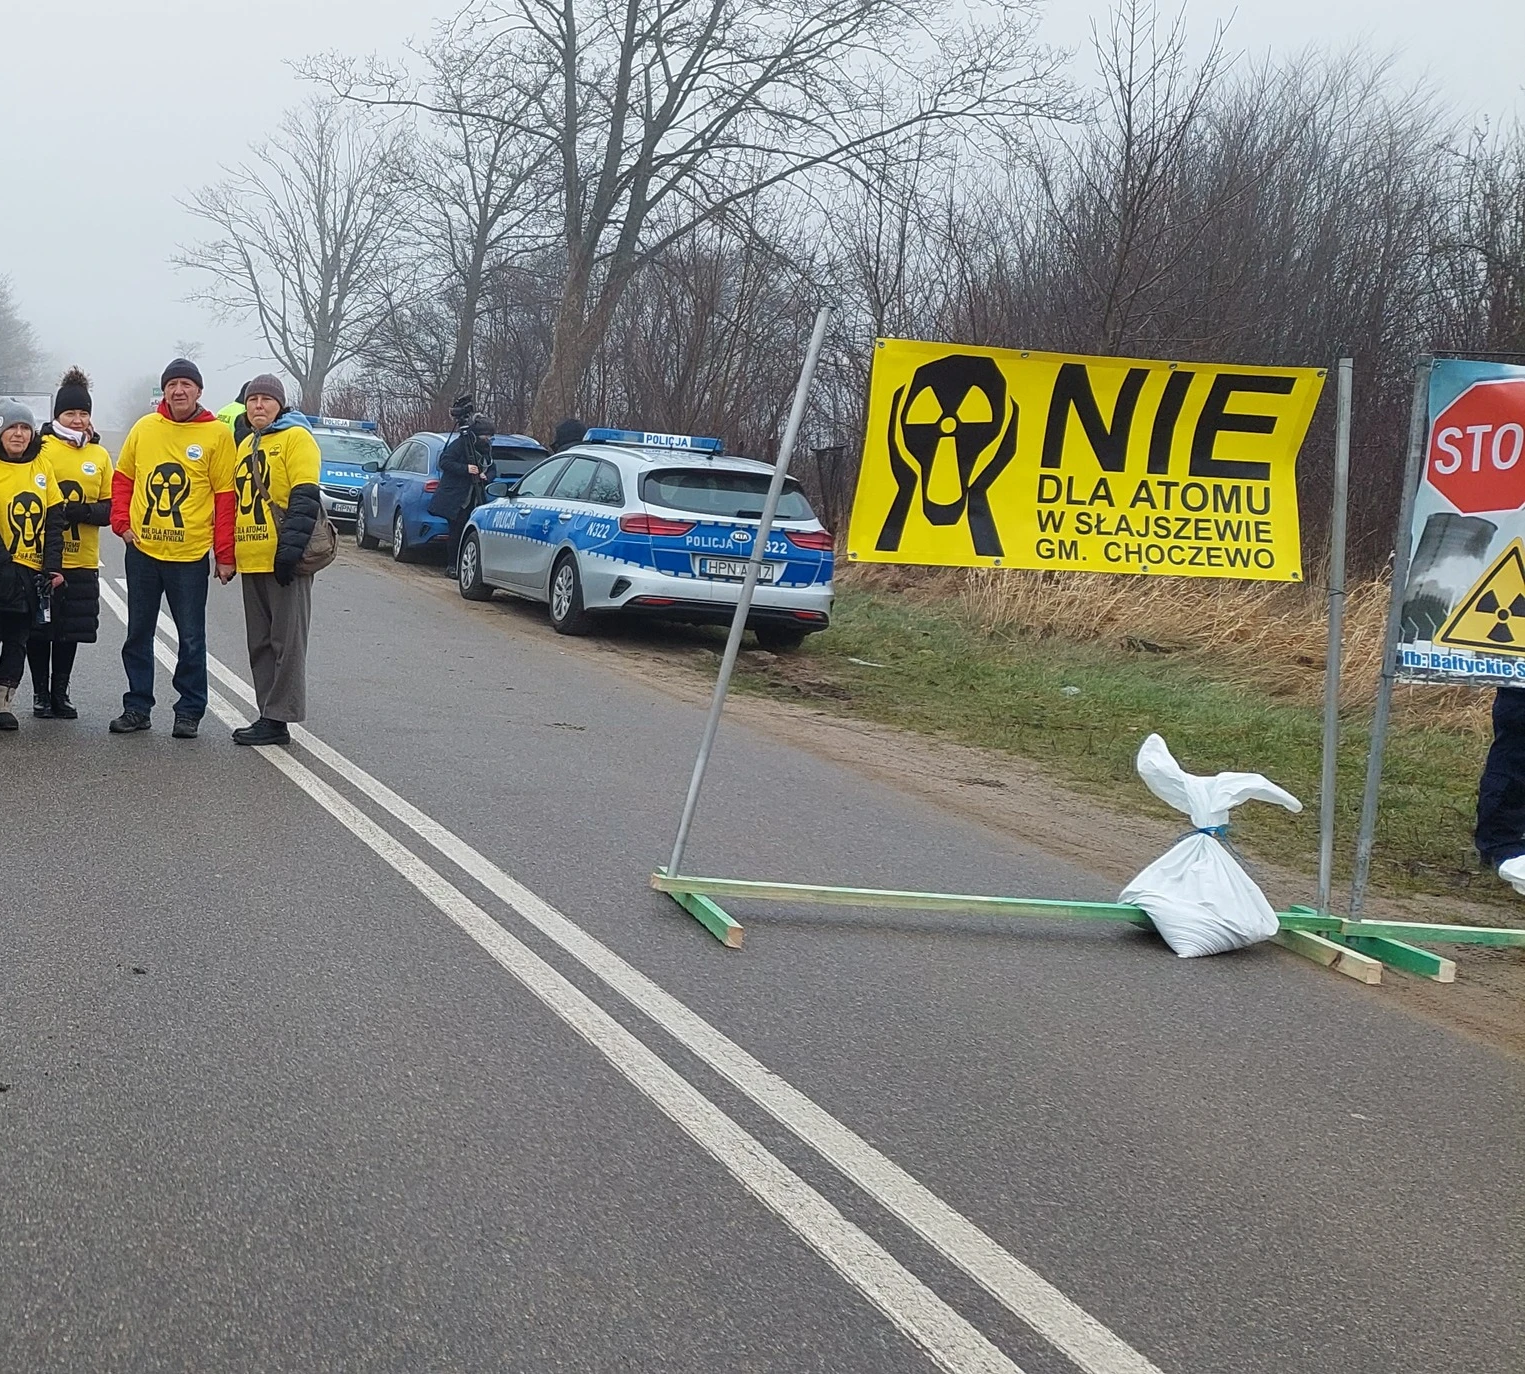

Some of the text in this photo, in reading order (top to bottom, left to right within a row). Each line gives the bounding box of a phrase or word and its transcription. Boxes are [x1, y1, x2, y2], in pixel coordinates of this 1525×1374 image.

[1040, 362, 1298, 481] NIE
[646, 434, 688, 448] POLICJA
[326, 470, 374, 480] POLICJ
[1036, 473, 1272, 516] DLA ATOMU
[586, 521, 611, 539] N322
[1036, 509, 1274, 544] W SŁAJSZEWIE
[685, 536, 734, 549] POLICJA
[754, 540, 788, 554] 322
[1035, 538, 1275, 569] GM. CHOCZEWO
[708, 561, 737, 575] HPN
[1403, 650, 1428, 667] fb:
[1430, 652, 1513, 677] Bałtyckie
